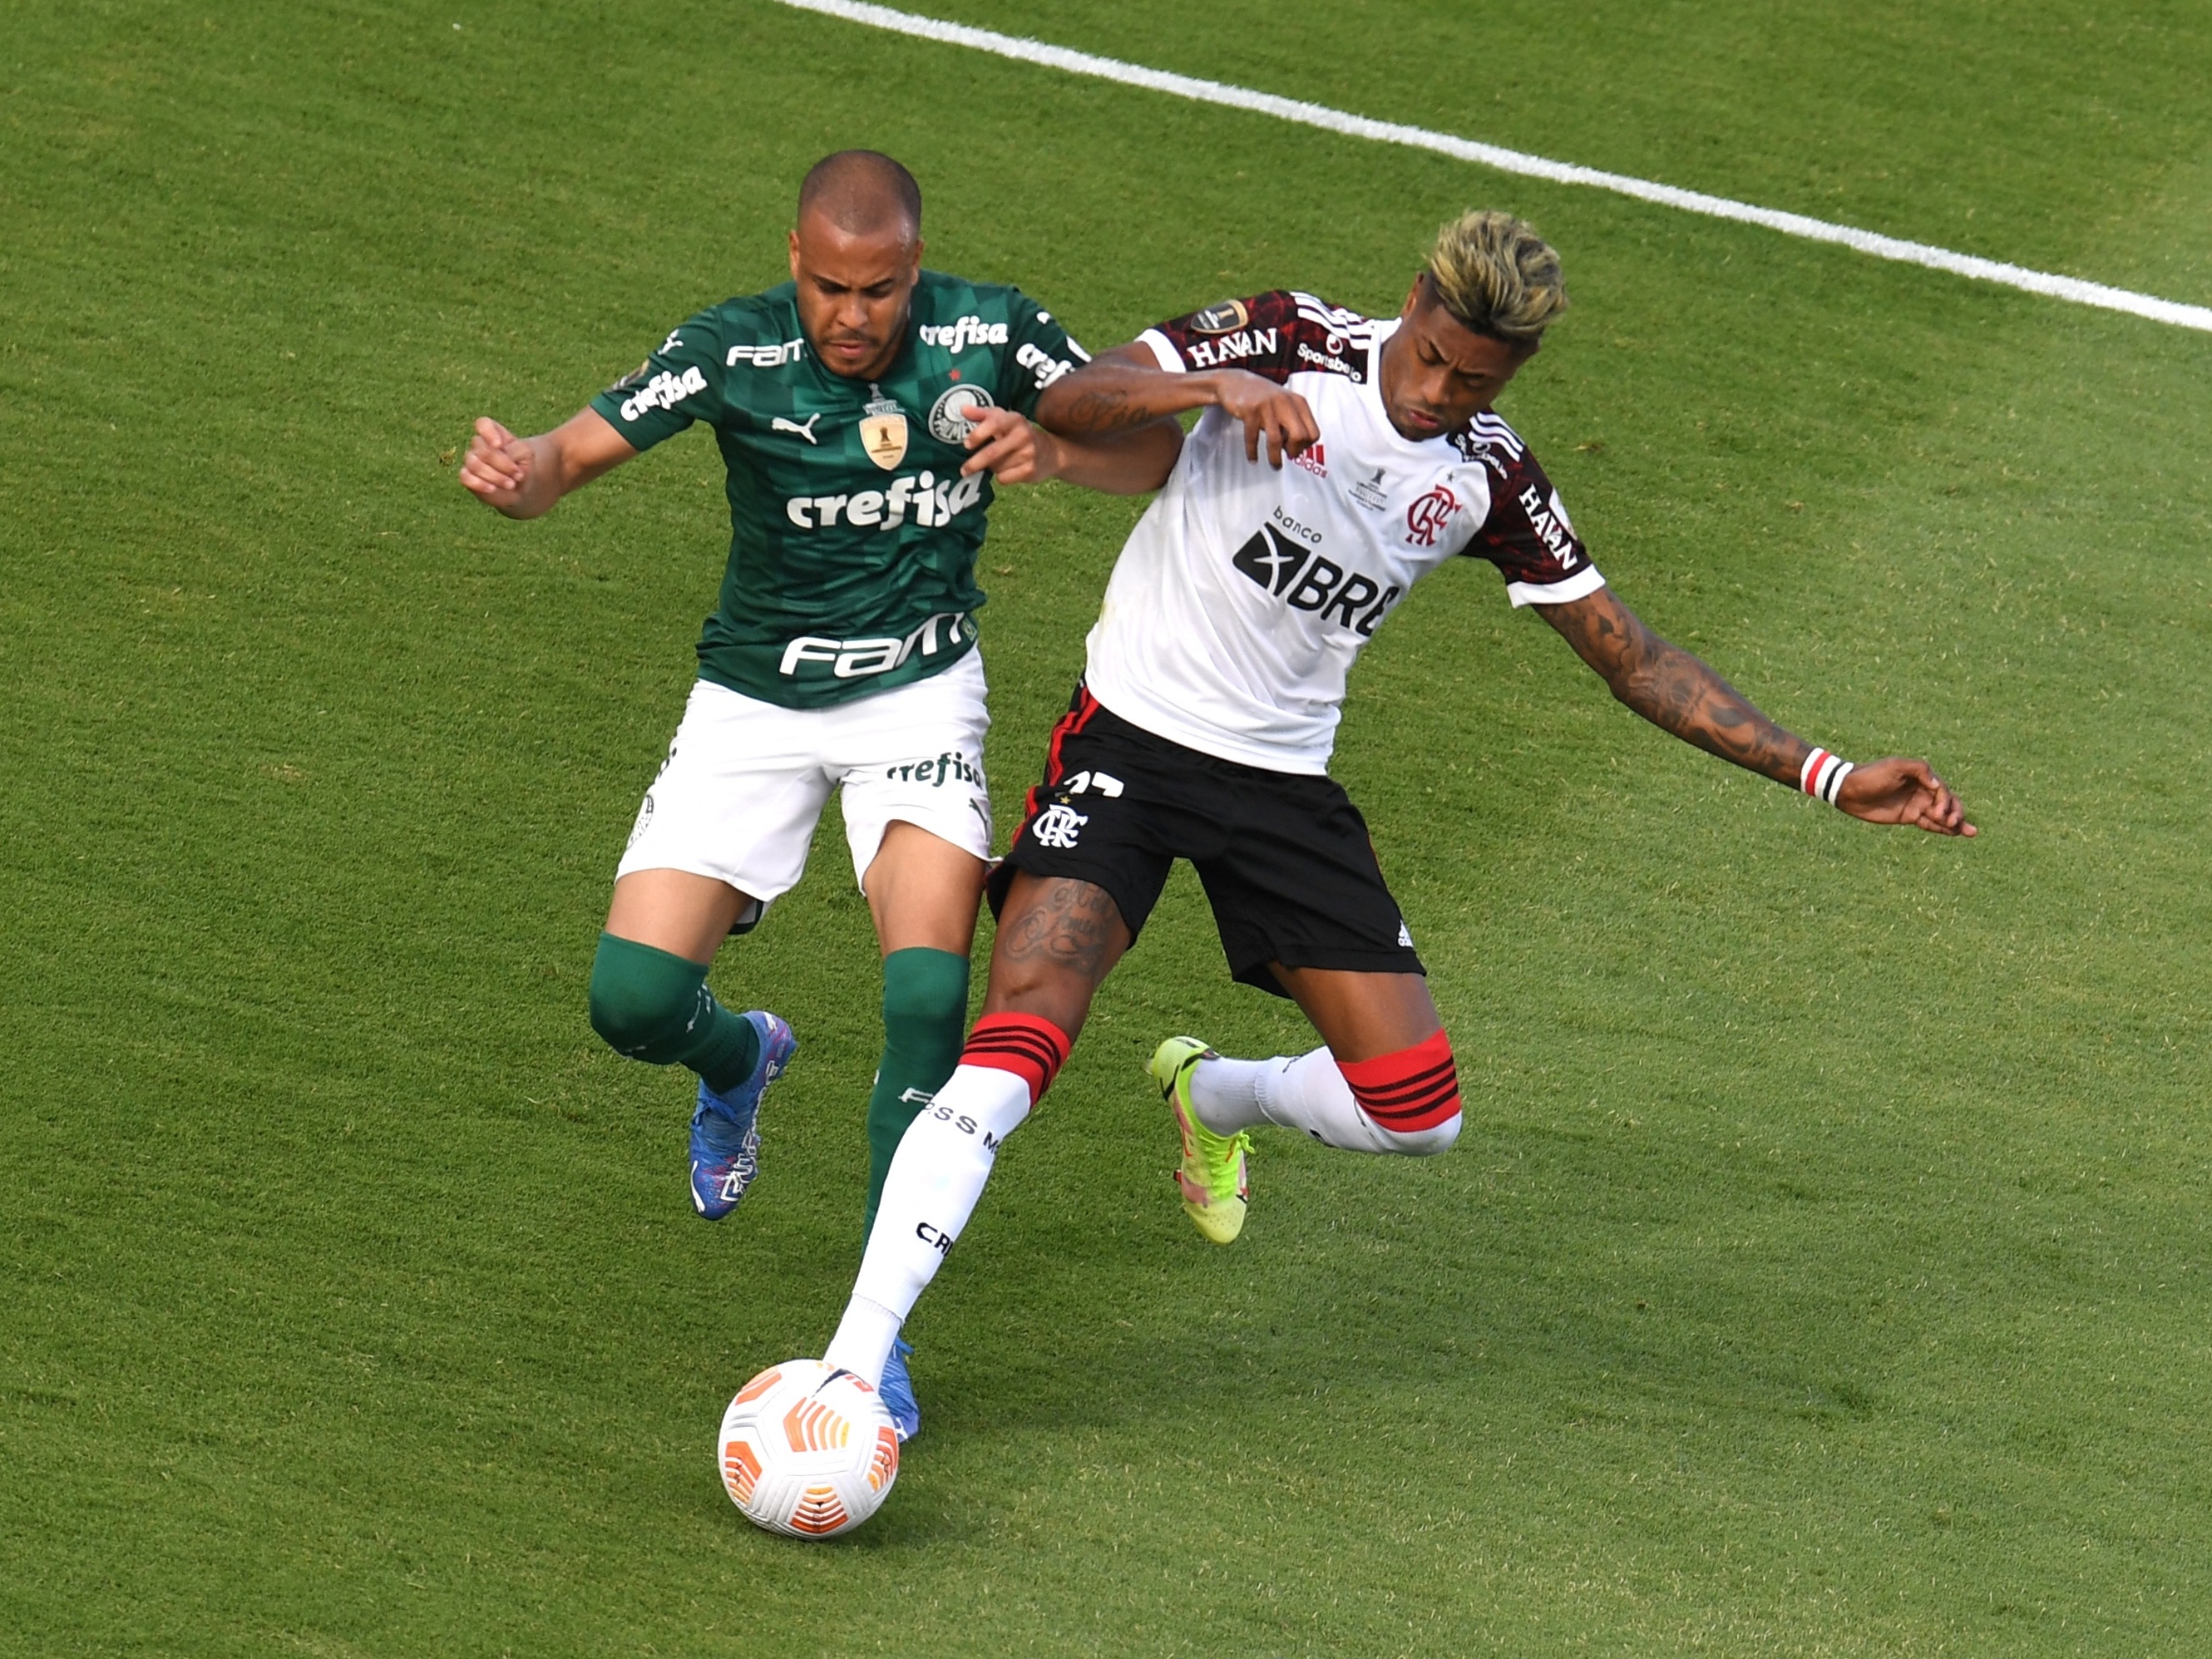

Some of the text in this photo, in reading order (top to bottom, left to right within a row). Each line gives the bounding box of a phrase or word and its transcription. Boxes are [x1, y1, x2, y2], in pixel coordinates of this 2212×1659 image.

[919, 315, 1009, 354] crefisa
[1187, 328, 1277, 368] HAVAN
[620, 366, 708, 422] crefisa
[787, 470, 985, 531] crefisa
[1273, 505, 1322, 544] banco
[1518, 482, 1578, 570] HAVAN
